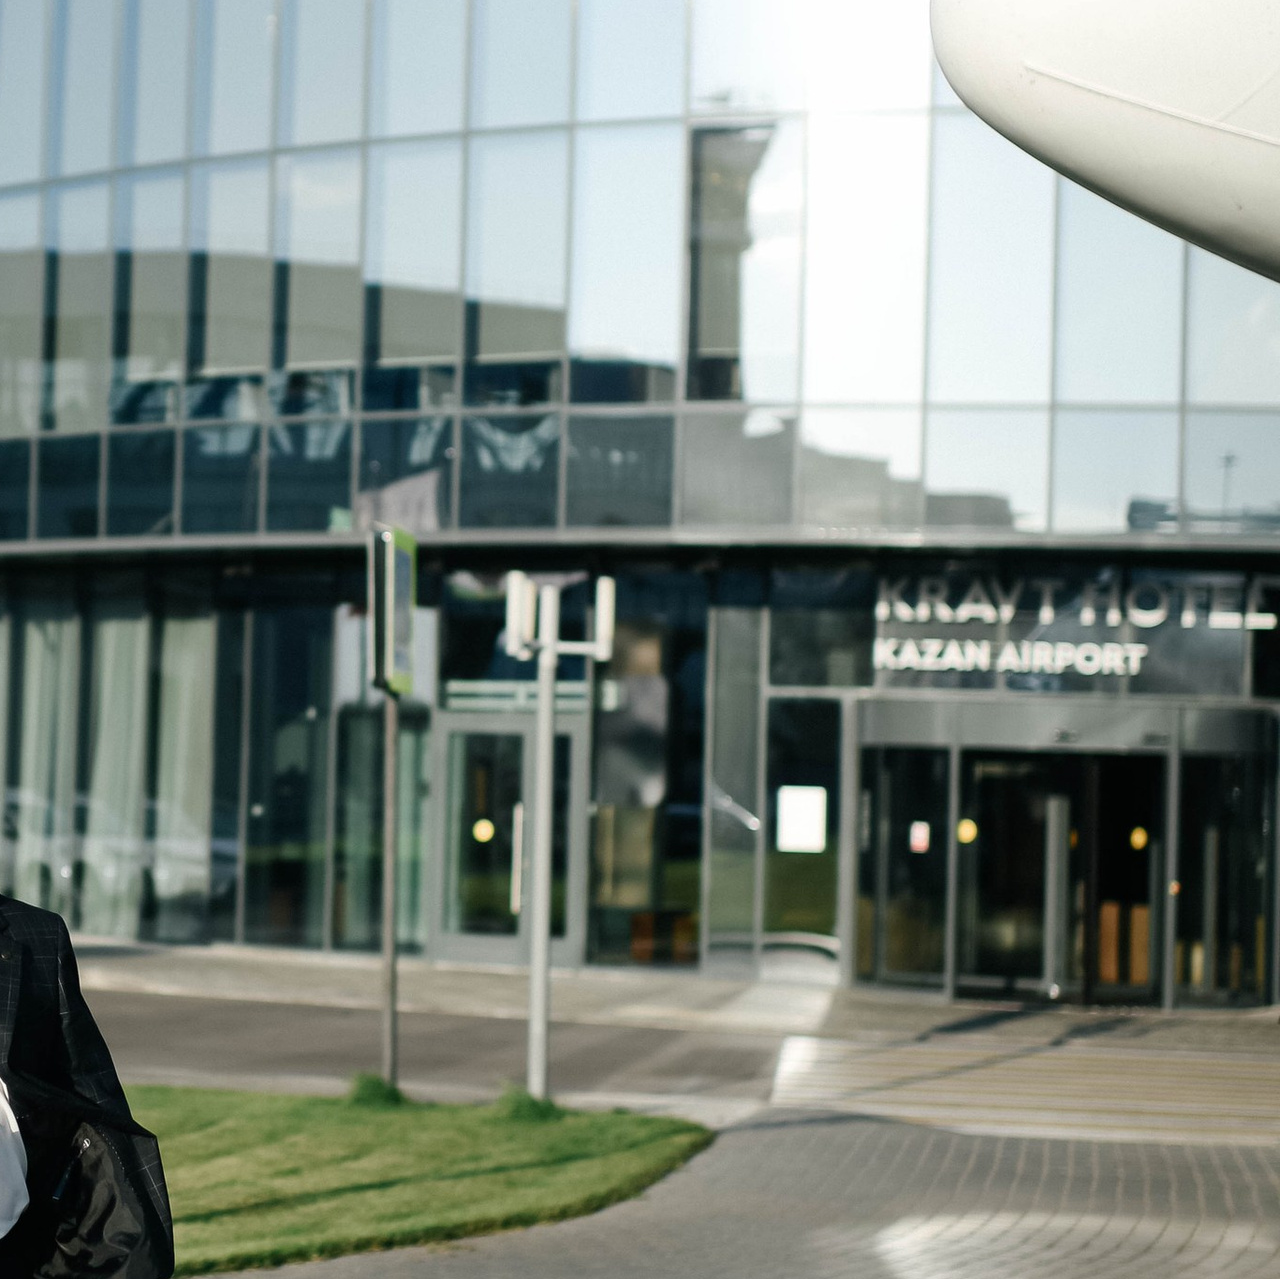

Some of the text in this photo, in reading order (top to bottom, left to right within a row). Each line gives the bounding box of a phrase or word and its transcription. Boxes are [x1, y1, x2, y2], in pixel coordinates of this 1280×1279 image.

[874, 578, 1278, 629] KRAVT HOTEL
[874, 638, 1149, 675] KAZAN AIRPORT
